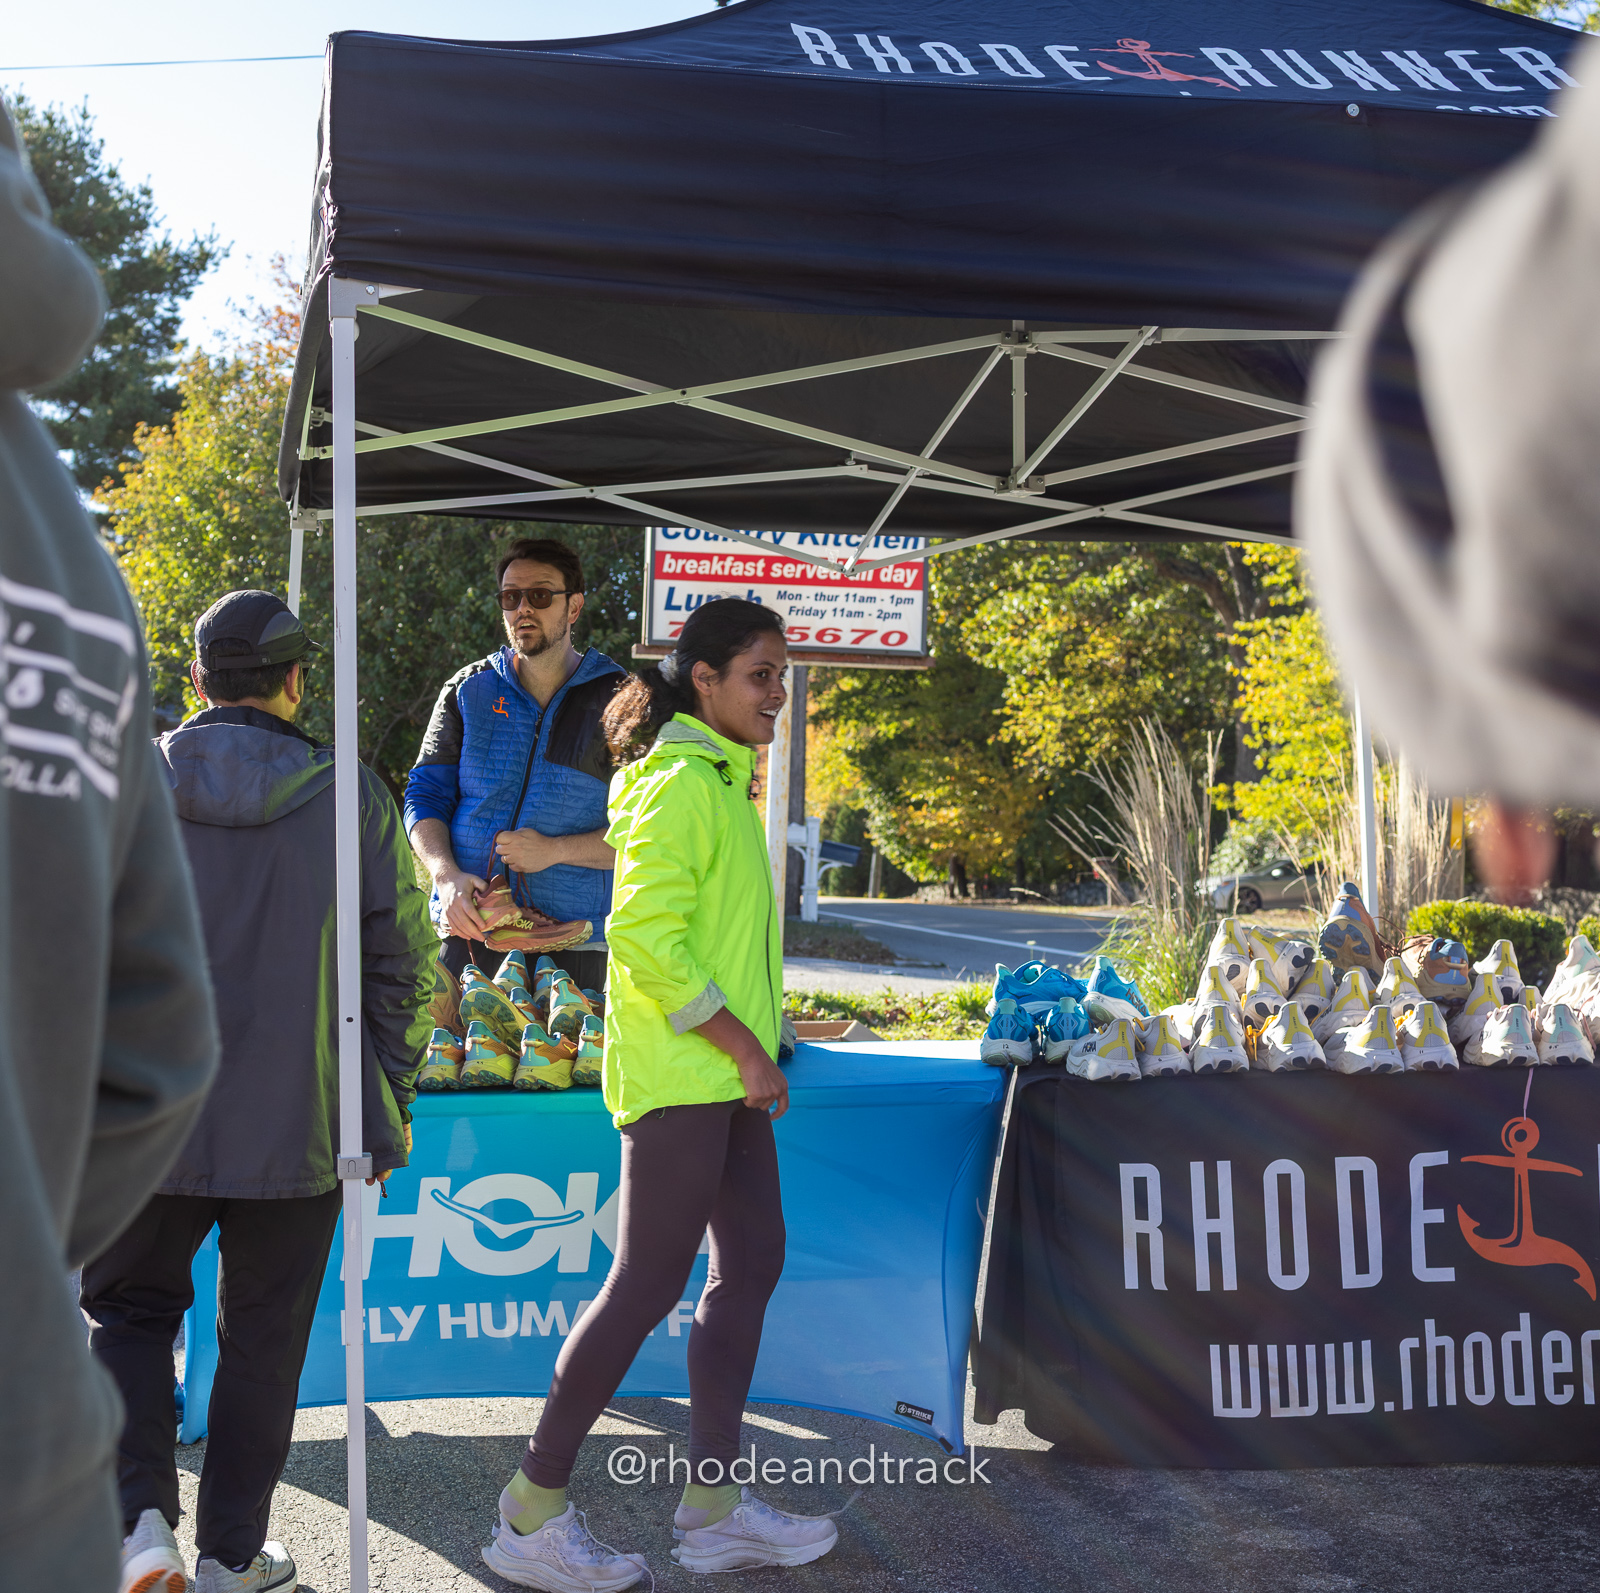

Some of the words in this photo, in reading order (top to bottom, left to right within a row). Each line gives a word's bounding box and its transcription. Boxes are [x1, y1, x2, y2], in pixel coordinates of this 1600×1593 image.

[791, 22, 1113, 82] RHODE
[1199, 46, 1584, 92] RUNNER
[662, 553, 766, 578] breakfast
[879, 563, 919, 588] day
[776, 590, 802, 601] Mon
[814, 591, 840, 602] thur
[844, 593, 877, 604] 11am
[889, 594, 915, 607] 1pm
[788, 606, 827, 619] Friday
[832, 607, 864, 618] 11am
[876, 609, 902, 621] 2pm
[340, 1172, 709, 1281] HOK
[1119, 1150, 1456, 1291] RHODE
[907, 1407, 932, 1420] STRIKE
